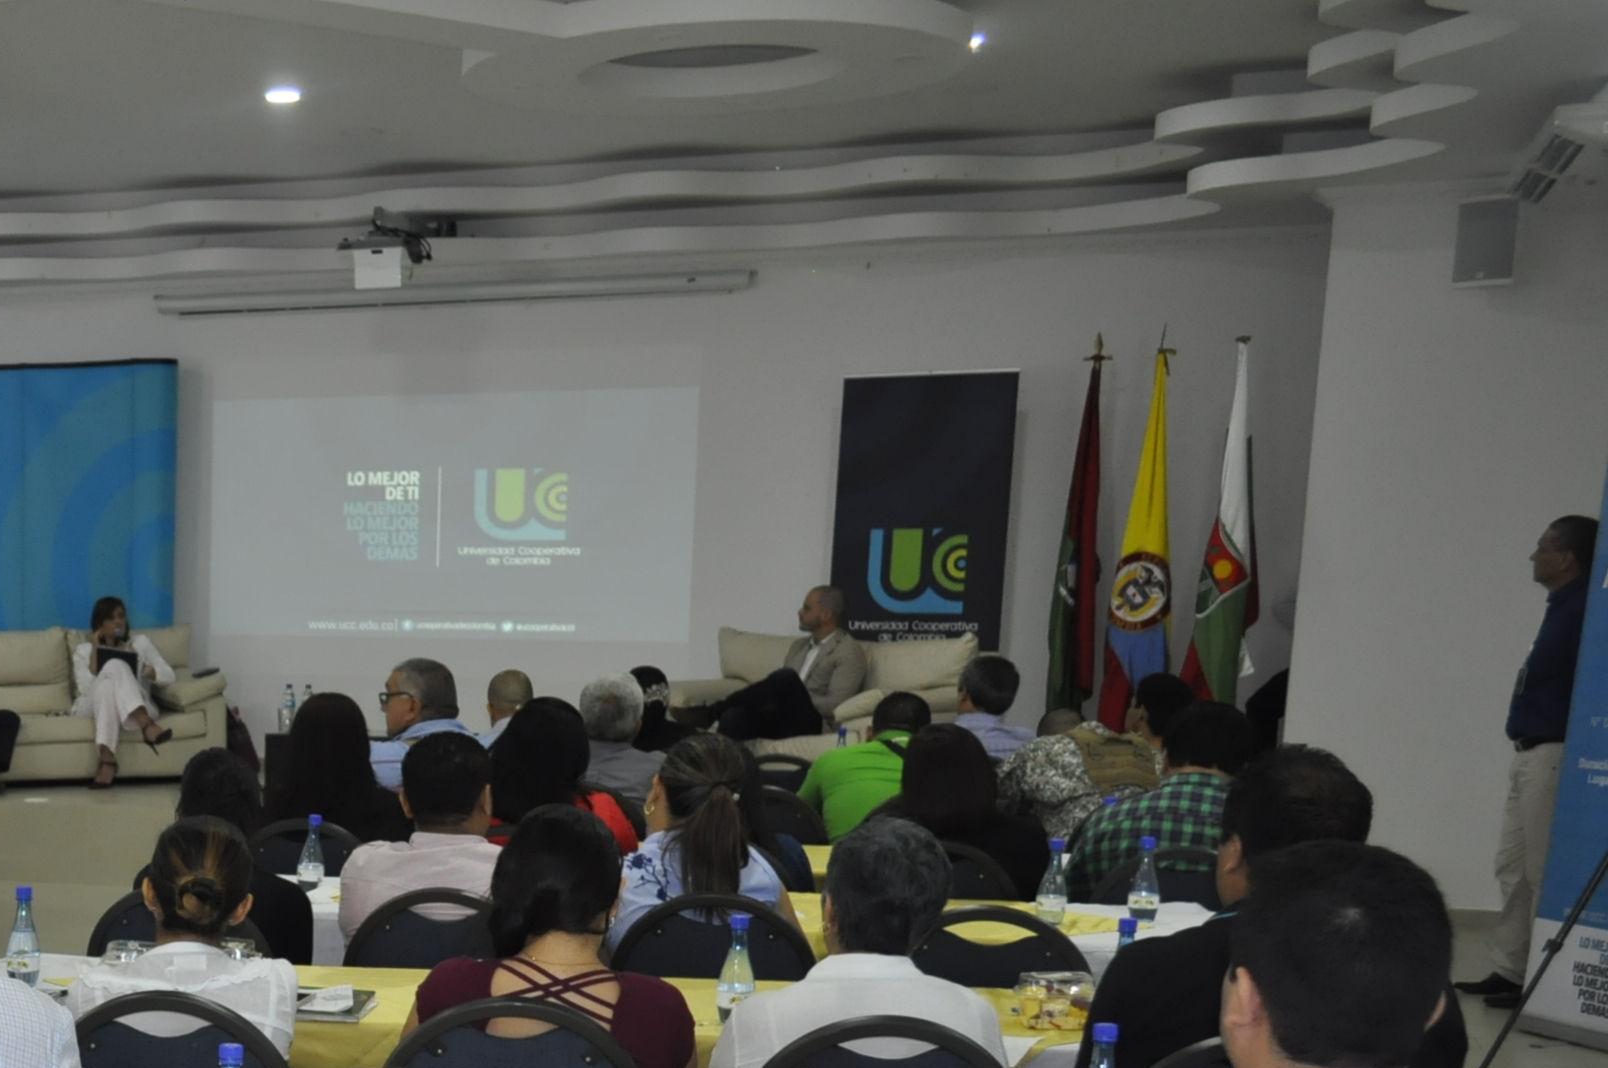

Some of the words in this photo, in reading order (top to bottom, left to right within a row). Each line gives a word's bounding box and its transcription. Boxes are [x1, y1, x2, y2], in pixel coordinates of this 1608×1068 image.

[347, 471, 366, 486] LO
[368, 470, 420, 486] MEJOR
[385, 486, 405, 501] DE
[406, 486, 419, 500] TI
[343, 501, 419, 516] HACIENDO
[346, 516, 364, 531] LO
[367, 516, 419, 531] MEJOR
[457, 546, 515, 556] Universidad
[517, 546, 581, 556] Cooperativa
[486, 556, 501, 566] de
[502, 556, 551, 566] Colombia
[848, 620, 909, 631] Universidad
[912, 620, 978, 632] Cooperativa
